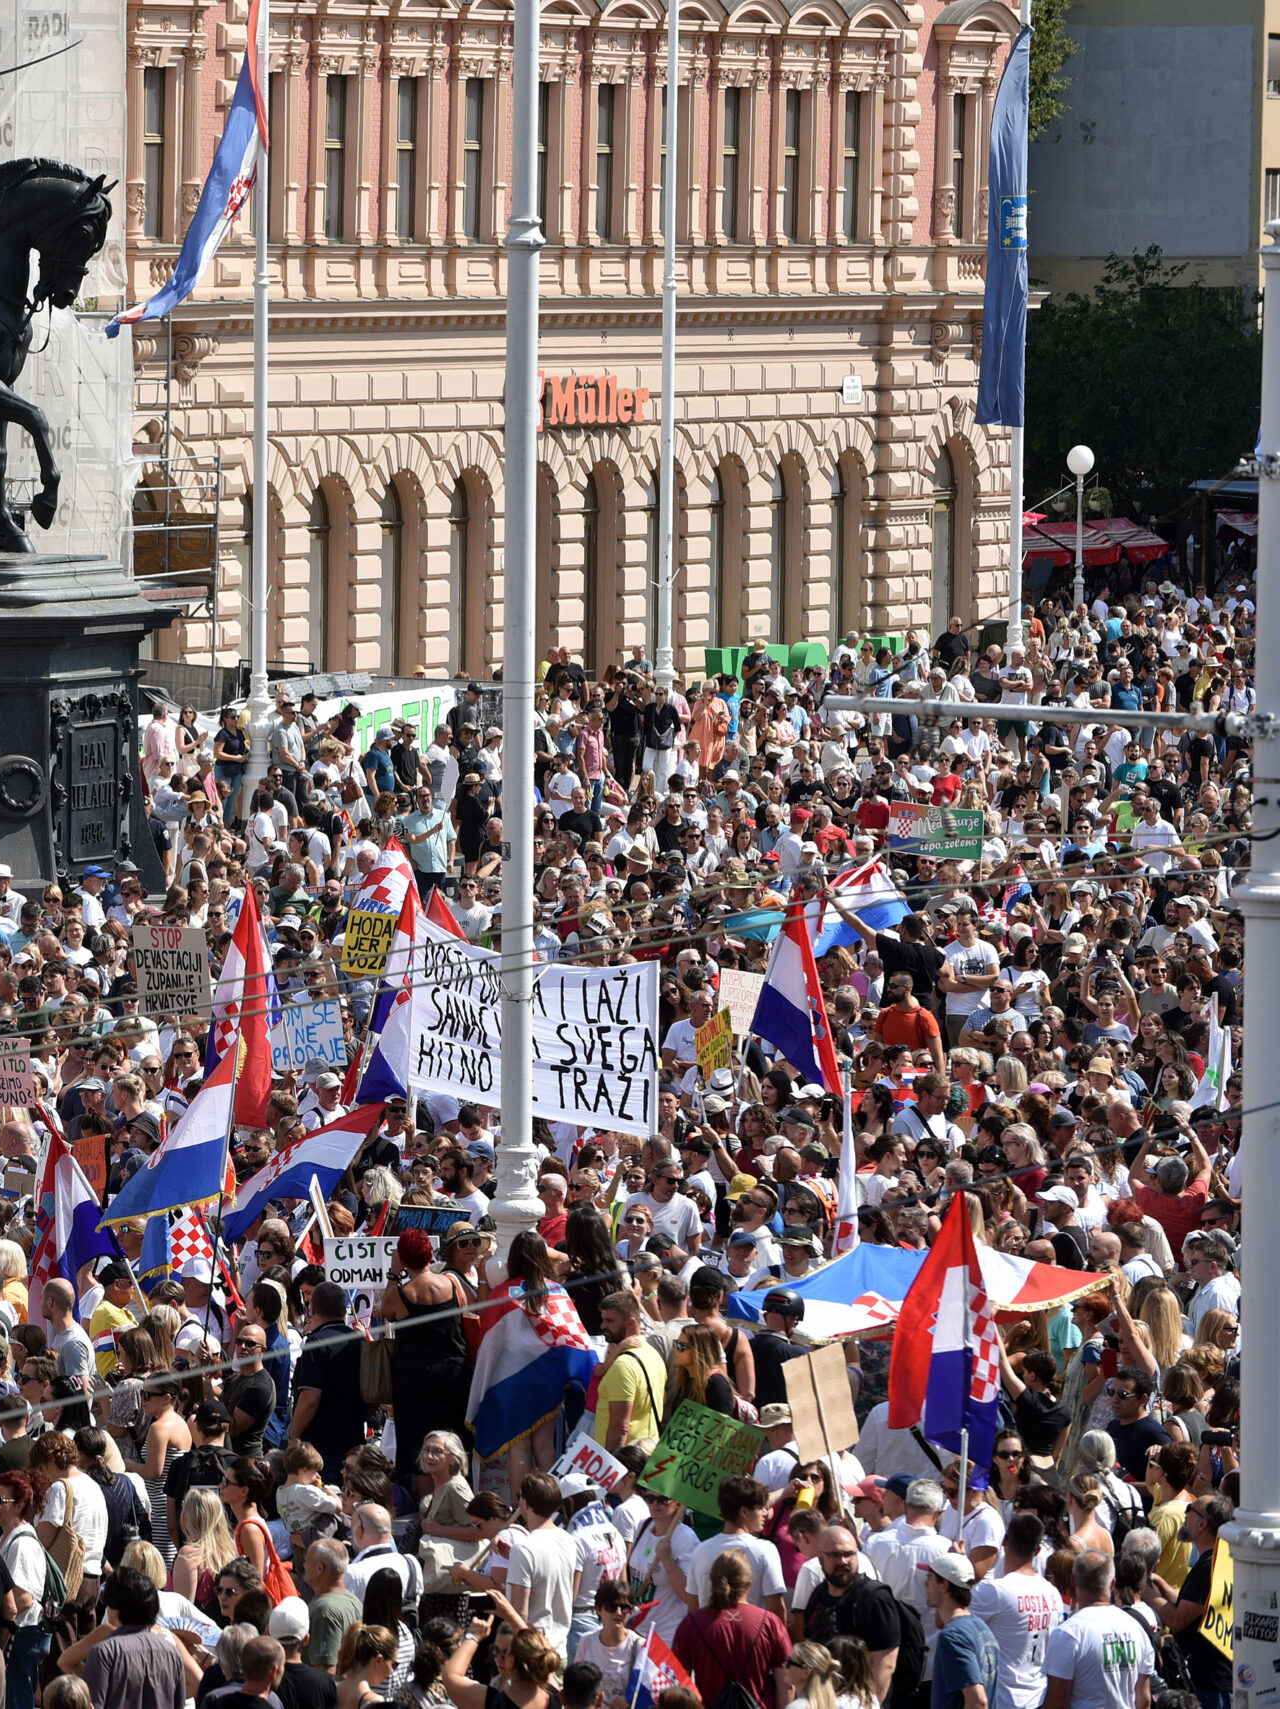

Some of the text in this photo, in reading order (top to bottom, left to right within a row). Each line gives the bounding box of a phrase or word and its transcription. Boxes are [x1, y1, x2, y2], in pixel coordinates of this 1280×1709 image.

[549, 375, 650, 425] Müller
[80, 741, 107, 770] BAN
[945, 838, 978, 850] zeleno
[151, 929, 184, 952] STOP
[348, 937, 381, 953] JER
[136, 949, 202, 973] DEVASTACIJI
[424, 936, 474, 996] DOSTA
[561, 976, 569, 1021] I
[583, 970, 642, 1025] LAŽI
[312, 1001, 337, 1026] SE
[295, 1026, 318, 1046] NE
[556, 1024, 659, 1074] SVEGA
[3, 1058, 7, 1072] I
[8, 1058, 27, 1073] TLO
[418, 1033, 494, 1093] HITNO
[551, 1065, 650, 1124] TRAŽI
[335, 1240, 377, 1261] ČIST
[330, 1267, 383, 1284] ODMAH
[571, 1444, 620, 1493] MOJA
[674, 1457, 719, 1494] KRUG
[1017, 1595, 1050, 1614] DOSTA
